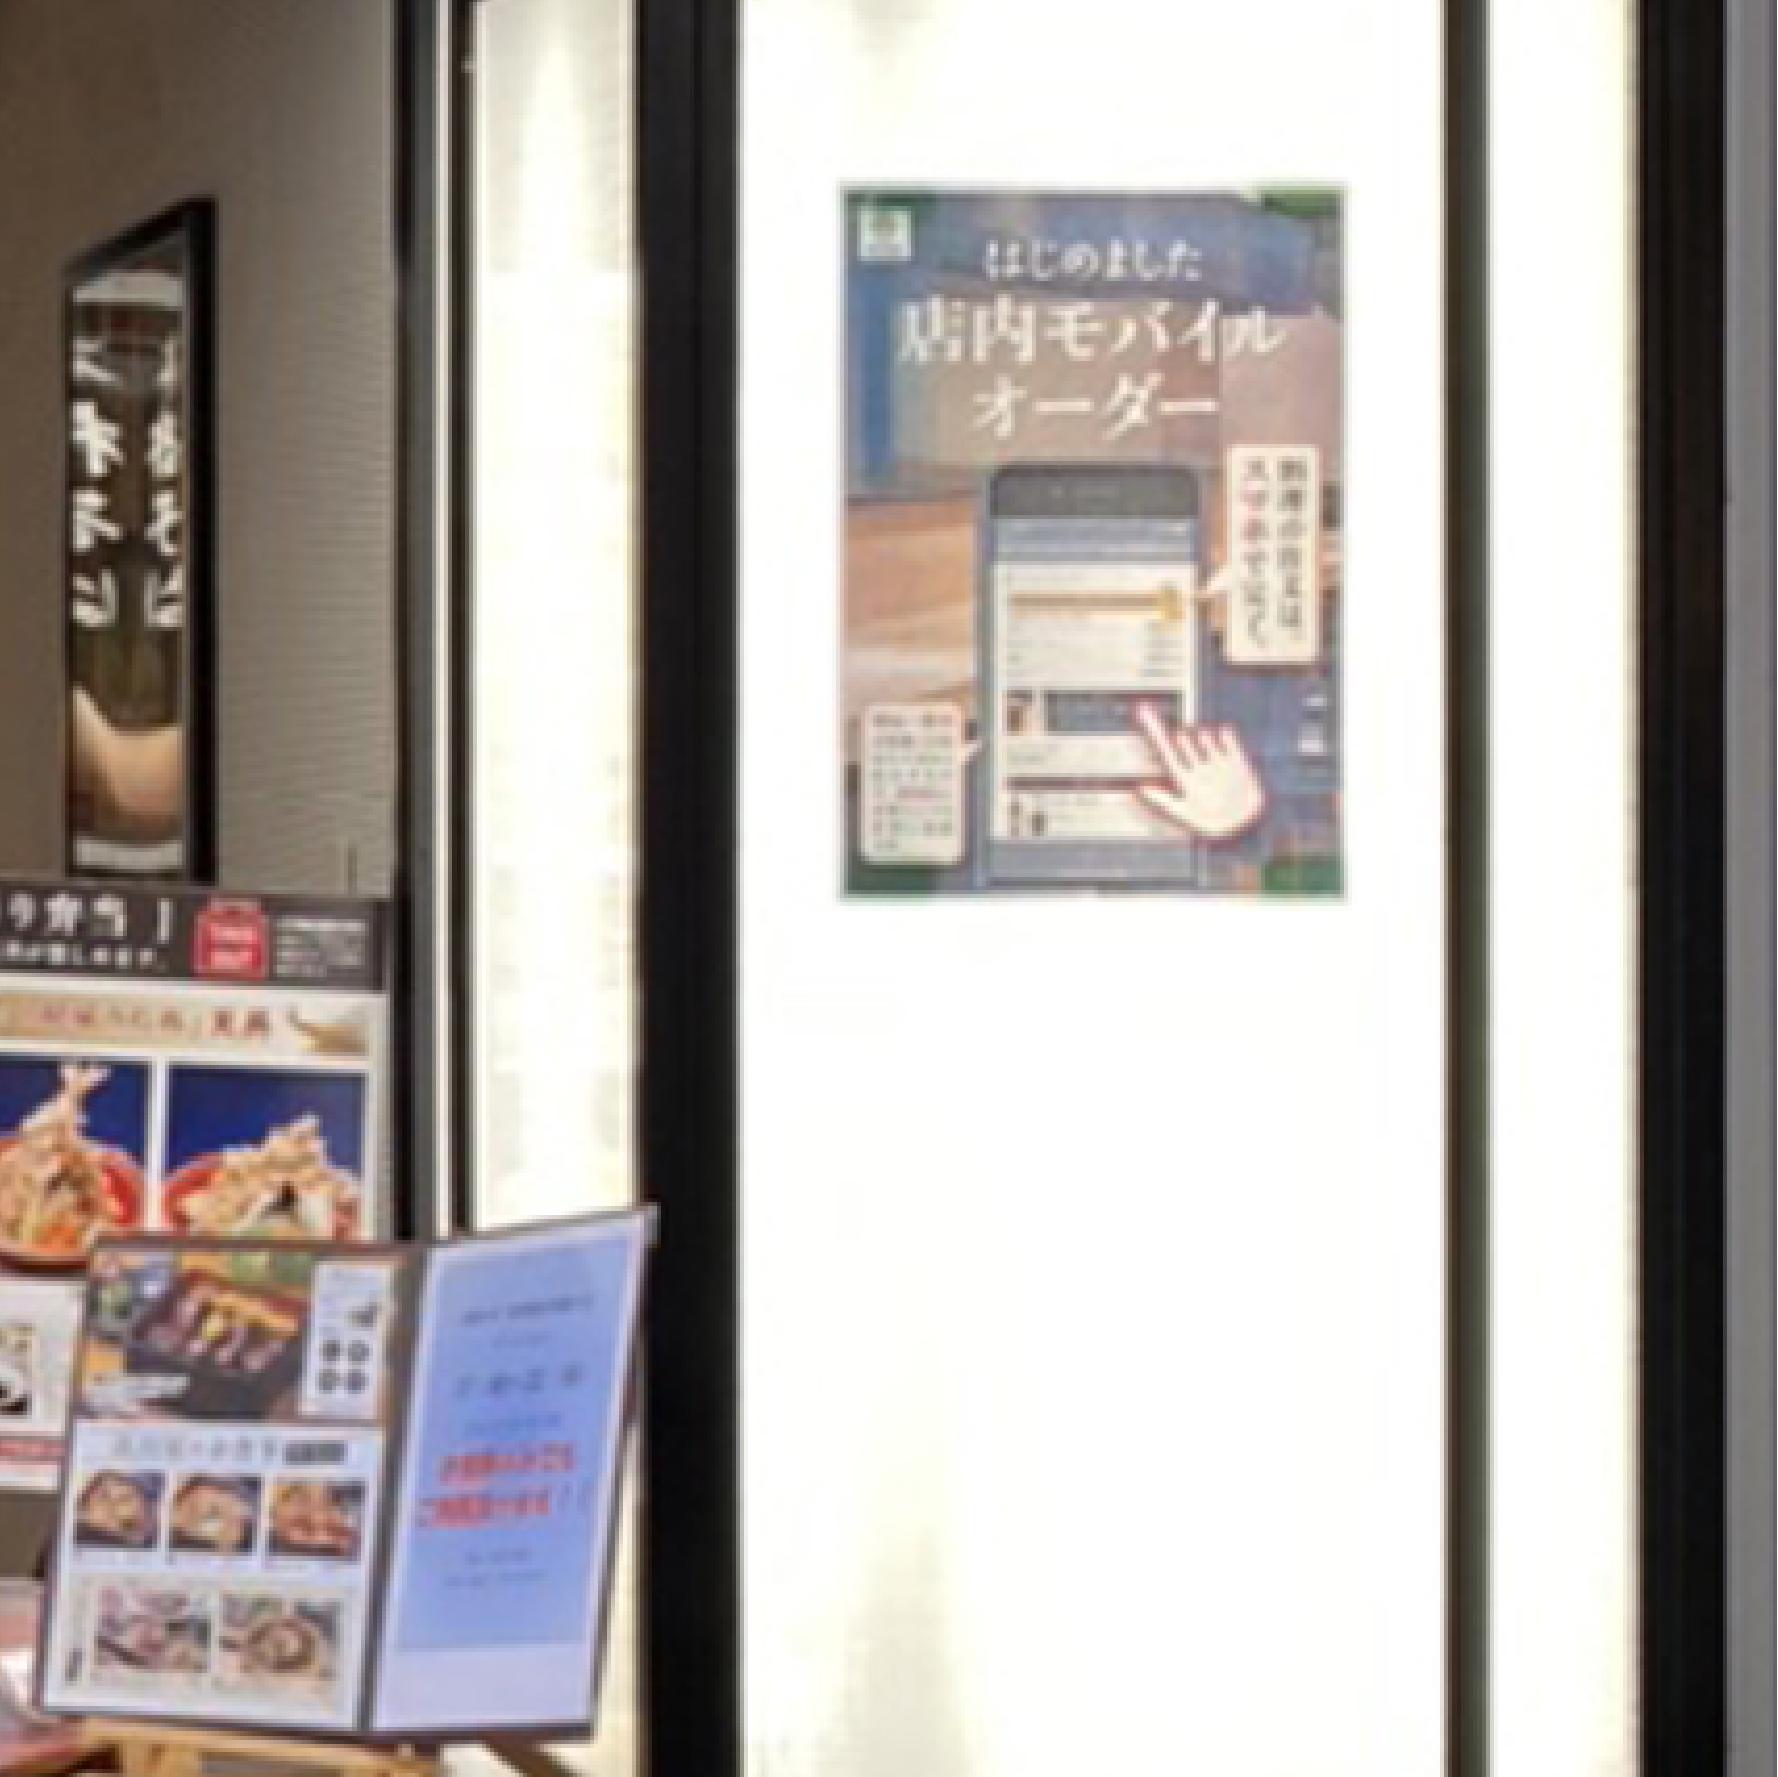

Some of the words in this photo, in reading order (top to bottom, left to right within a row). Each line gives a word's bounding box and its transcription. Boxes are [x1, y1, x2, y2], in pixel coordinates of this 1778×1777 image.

[984, 236, 1204, 282] はじめました
[897, 294, 1289, 364] 店内モバイル
[972, 373, 1221, 440] オーダー
